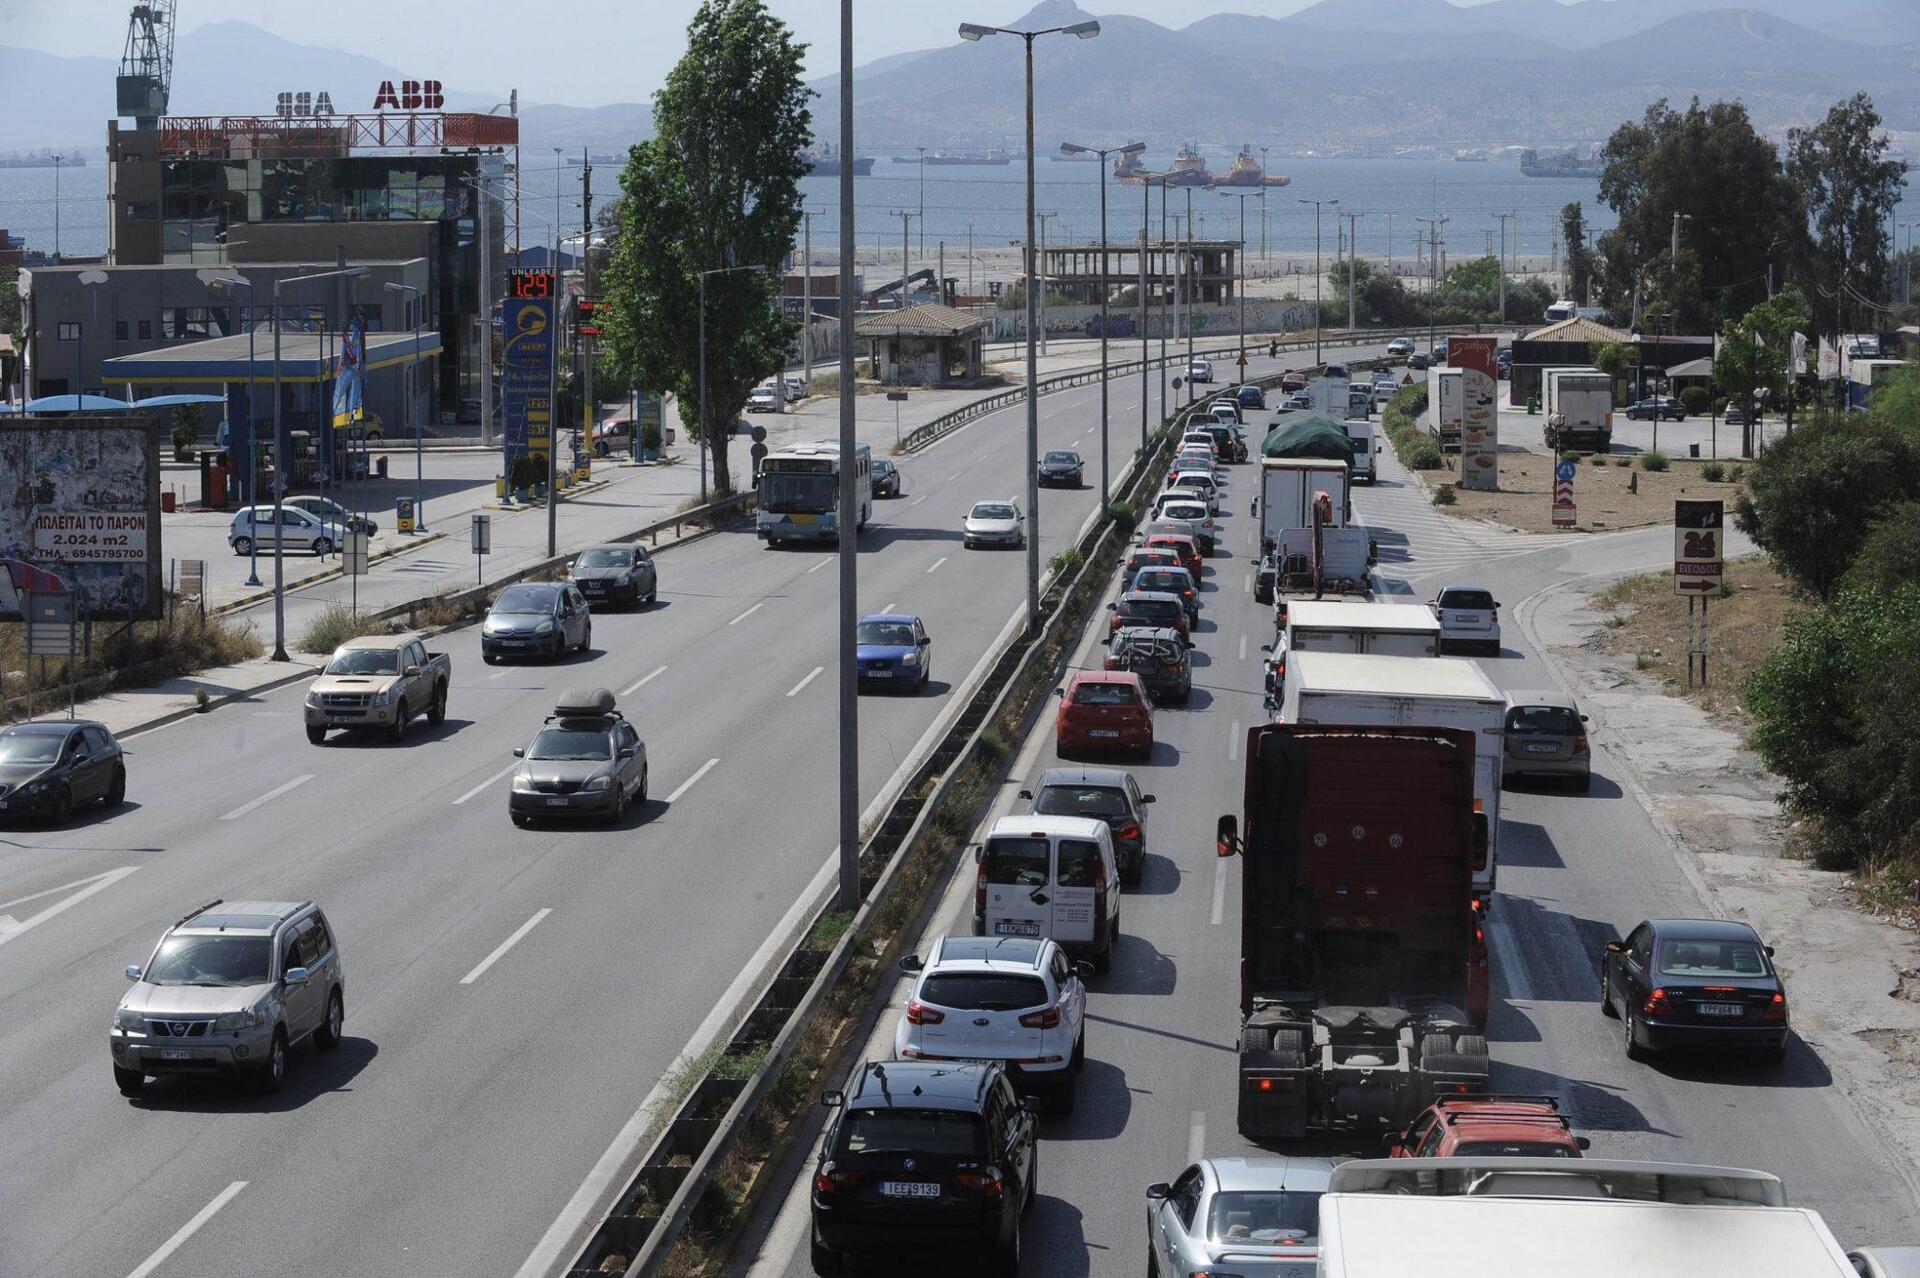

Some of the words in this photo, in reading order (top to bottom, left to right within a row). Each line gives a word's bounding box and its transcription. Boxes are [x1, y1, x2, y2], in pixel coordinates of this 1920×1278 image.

[373, 80, 444, 109] ABB
[35, 515, 86, 530] ΠΩΛΕΙΤΑΙ
[89, 515, 104, 530] ΤΟ
[107, 516, 145, 530] ΠΑΡΟΝ
[53, 535, 98, 545] 2.024
[103, 535, 128, 545] m2
[72, 550, 144, 558] 6945795700
